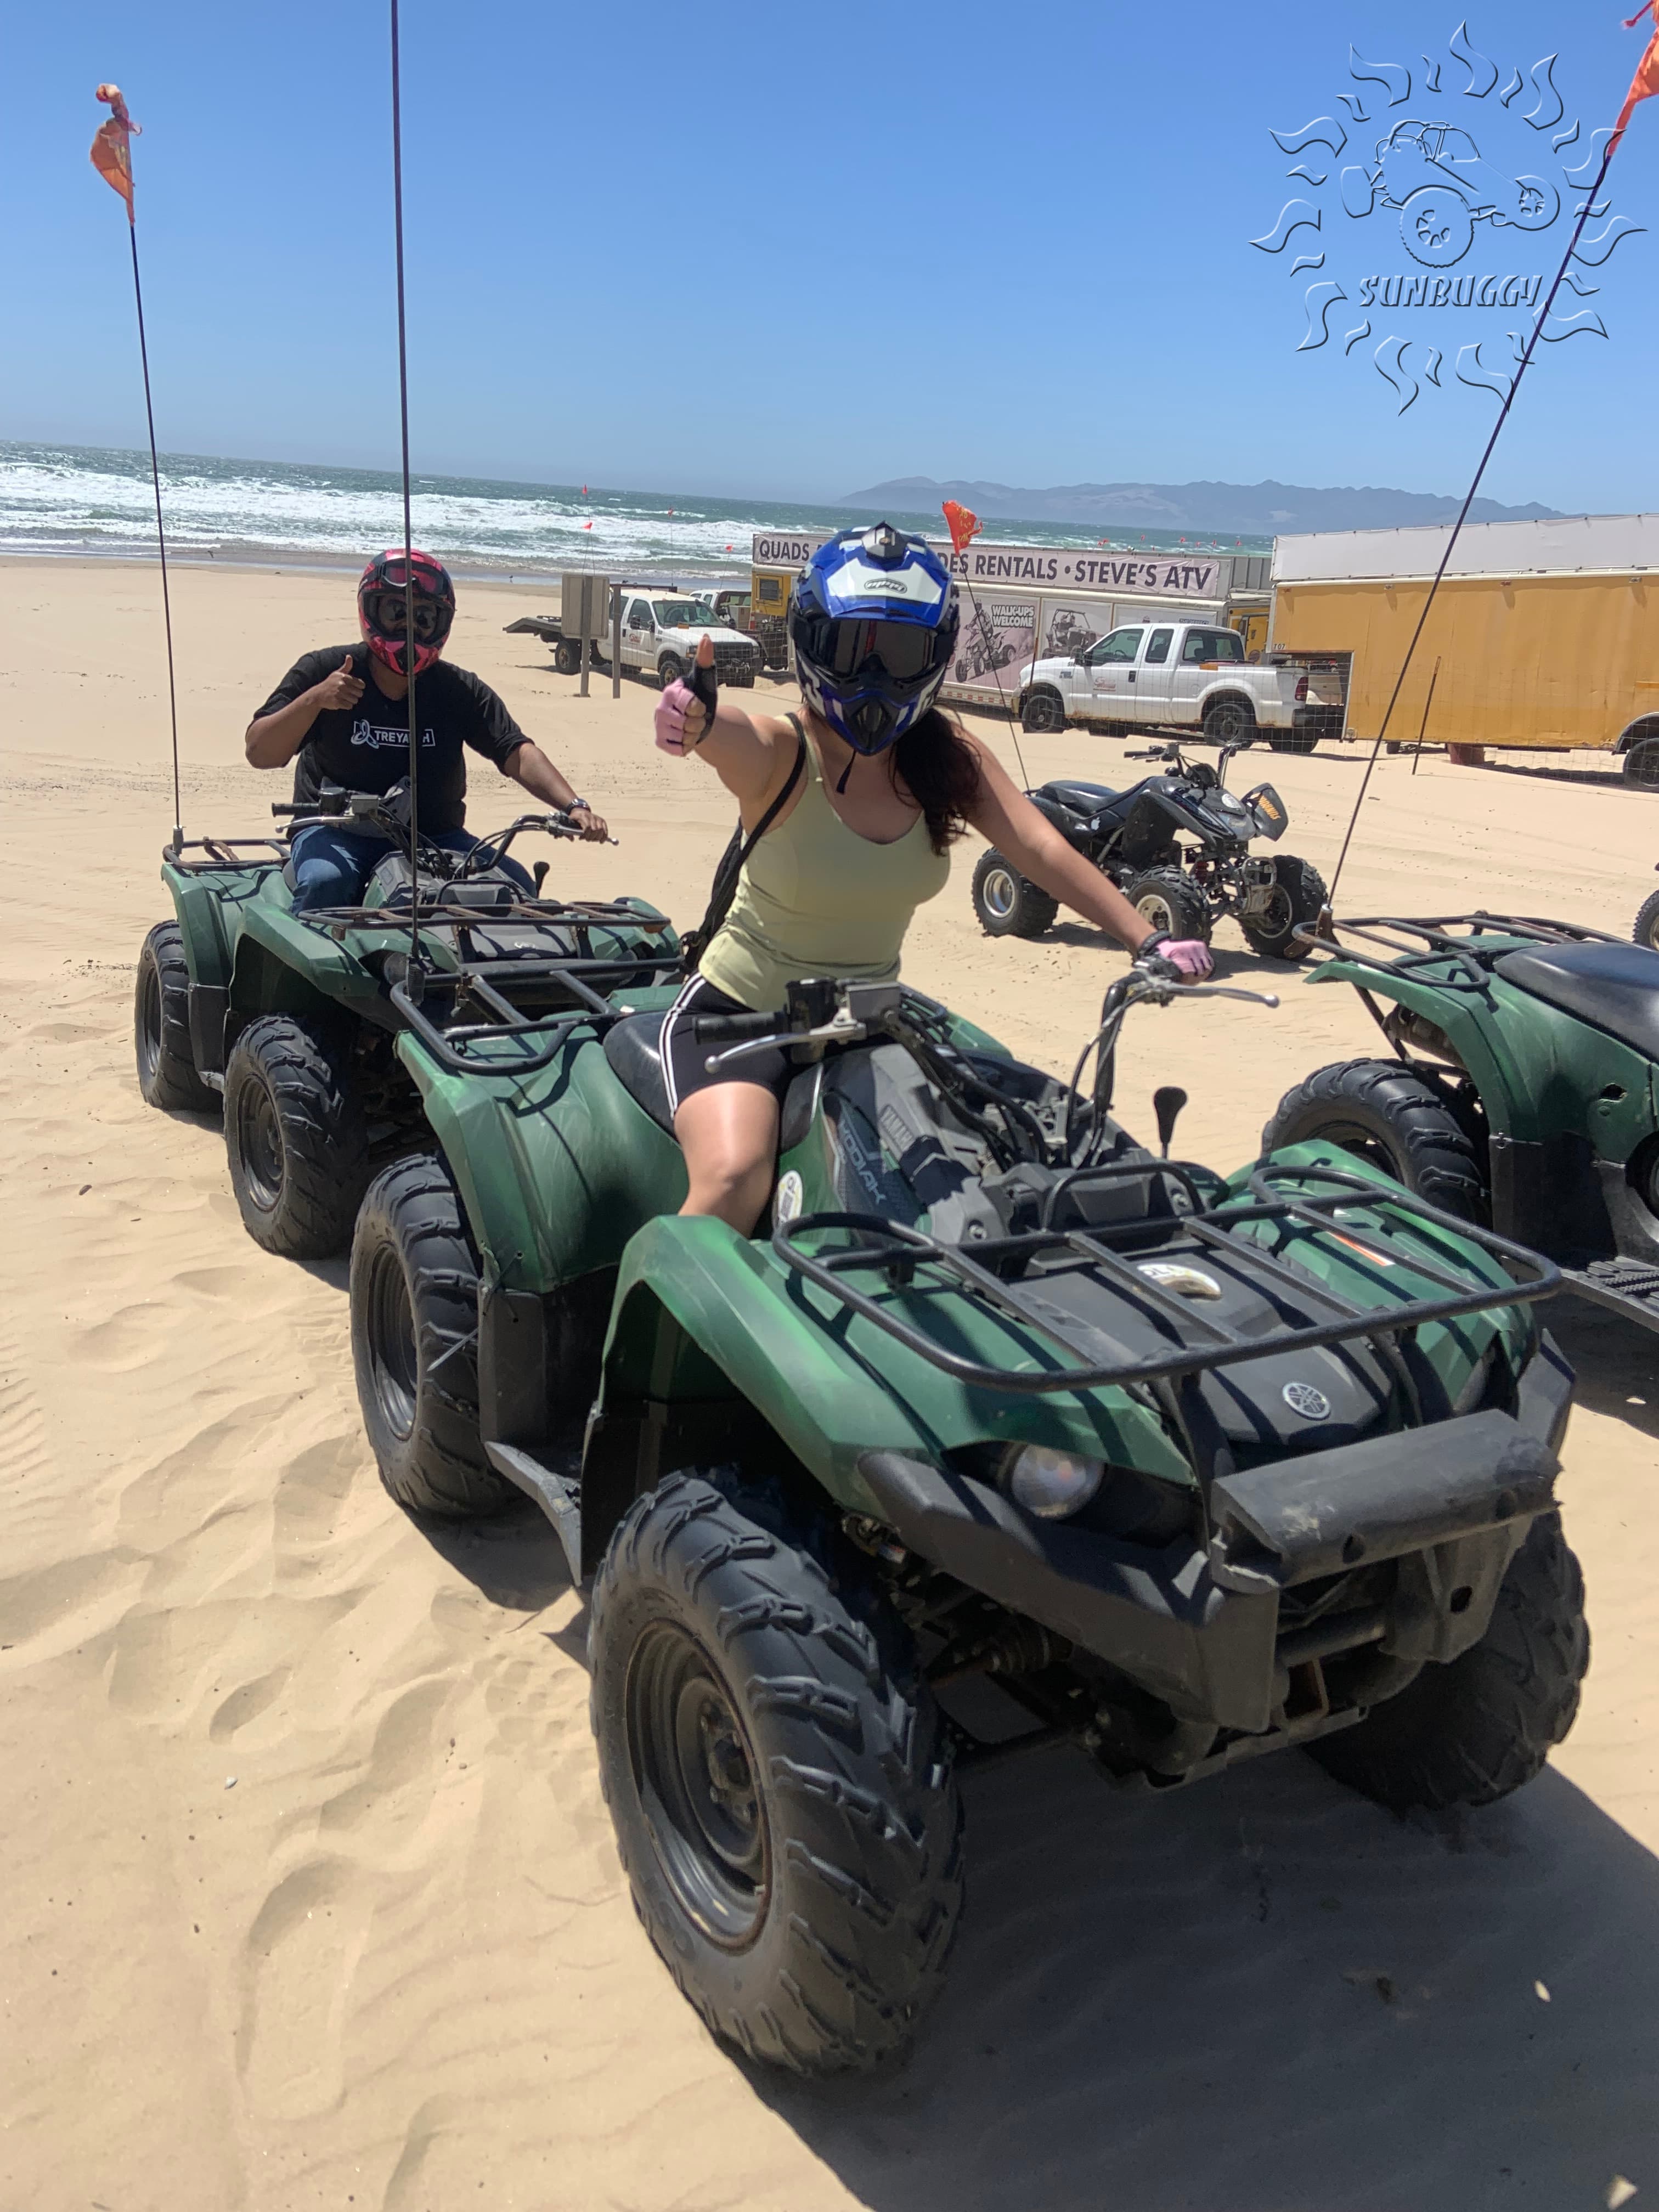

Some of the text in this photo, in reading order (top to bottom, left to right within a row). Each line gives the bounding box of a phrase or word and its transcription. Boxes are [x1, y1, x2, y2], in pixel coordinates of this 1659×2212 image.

[759, 540, 809, 561] QUADS
[975, 555, 1058, 580] RENTALS
[1075, 560, 1157, 586] STEVE'S
[1163, 566, 1212, 590] ATV
[991, 605, 1035, 617] WALK-UPS
[992, 615, 1034, 628] WELCOME
[374, 730, 430, 744] TREYAH
[880, 1105, 915, 1152] YAMAH
[838, 1118, 888, 1205] KODIAK
